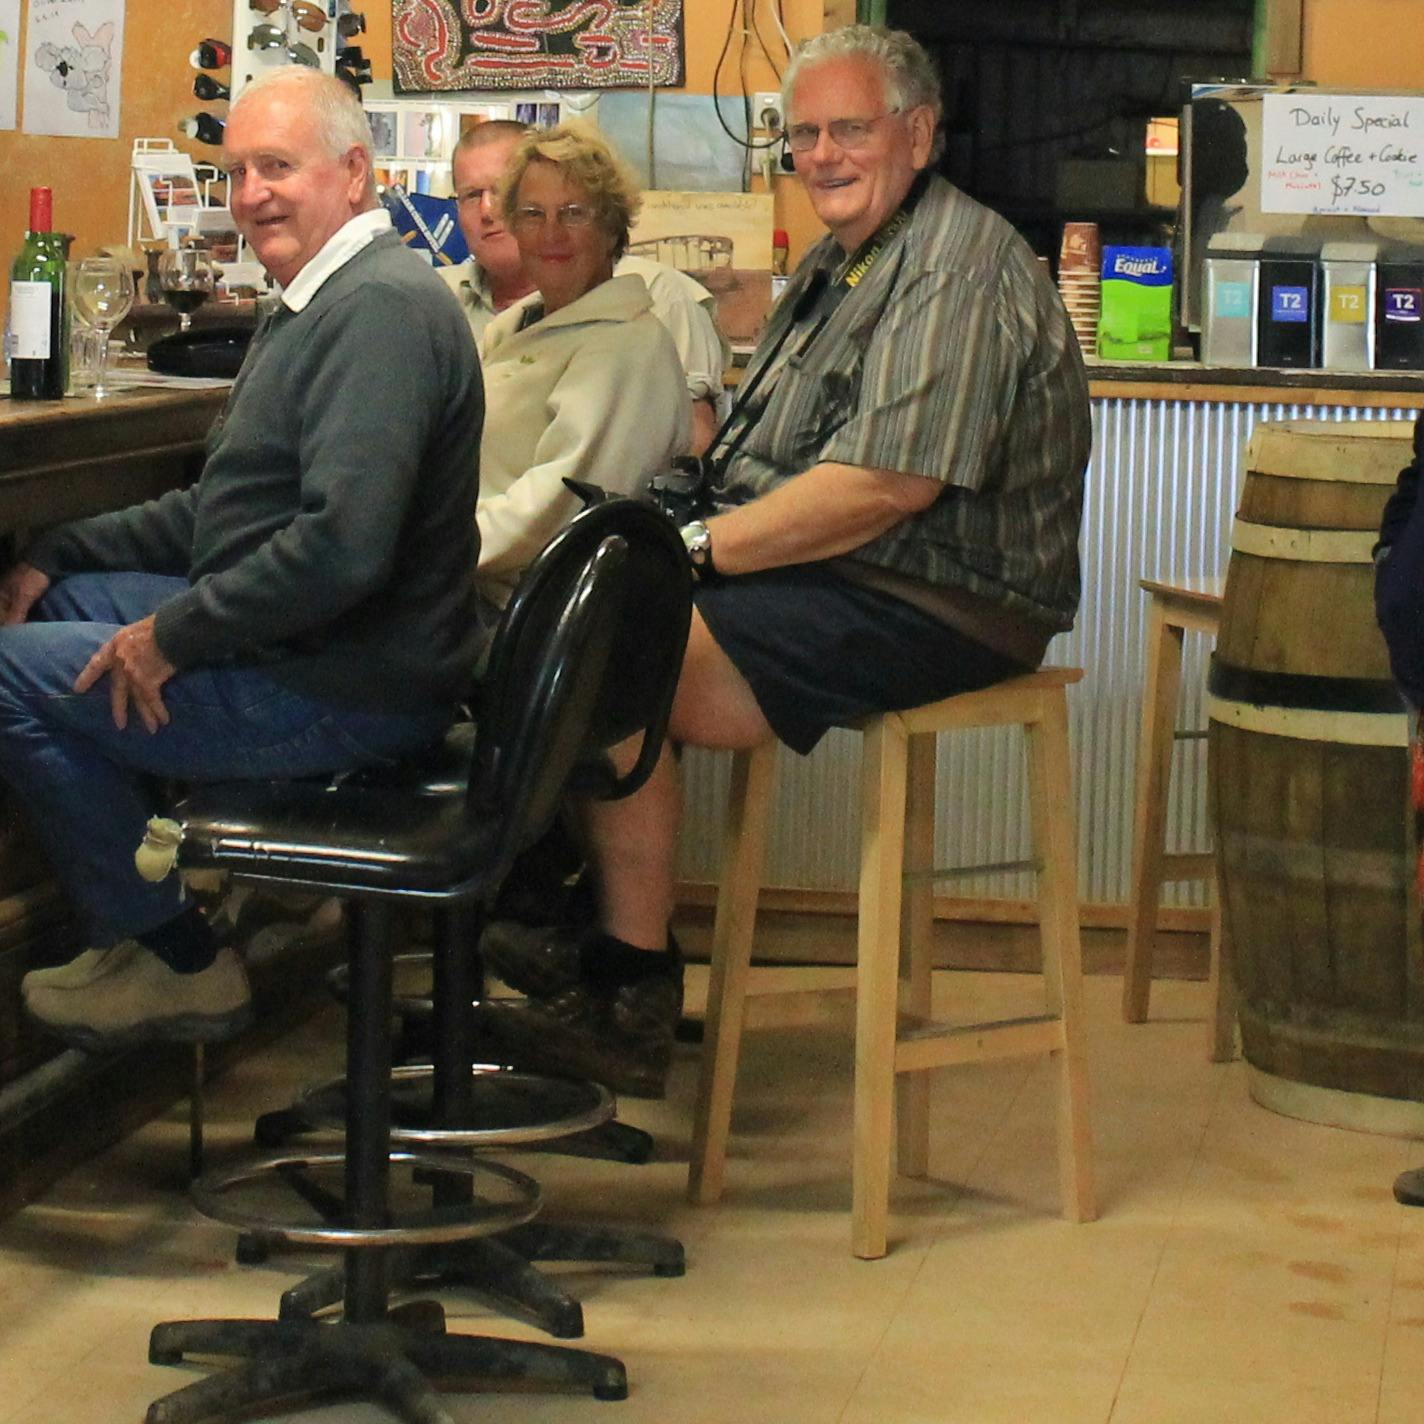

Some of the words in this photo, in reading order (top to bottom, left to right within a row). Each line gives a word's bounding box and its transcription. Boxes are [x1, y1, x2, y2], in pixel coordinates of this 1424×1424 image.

[1289, 107, 1341, 137] Daily
[1351, 107, 1410, 134] Special
[1276, 145, 1318, 171] Large
[1325, 145, 1364, 168] Coffee
[1378, 144, 1418, 164] Cookie
[1331, 175, 1386, 206] $7.50
[1224, 289, 1242, 306] T2
[1279, 292, 1301, 309] T2
[1338, 293, 1359, 309] T2
[1393, 293, 1415, 310] T2
